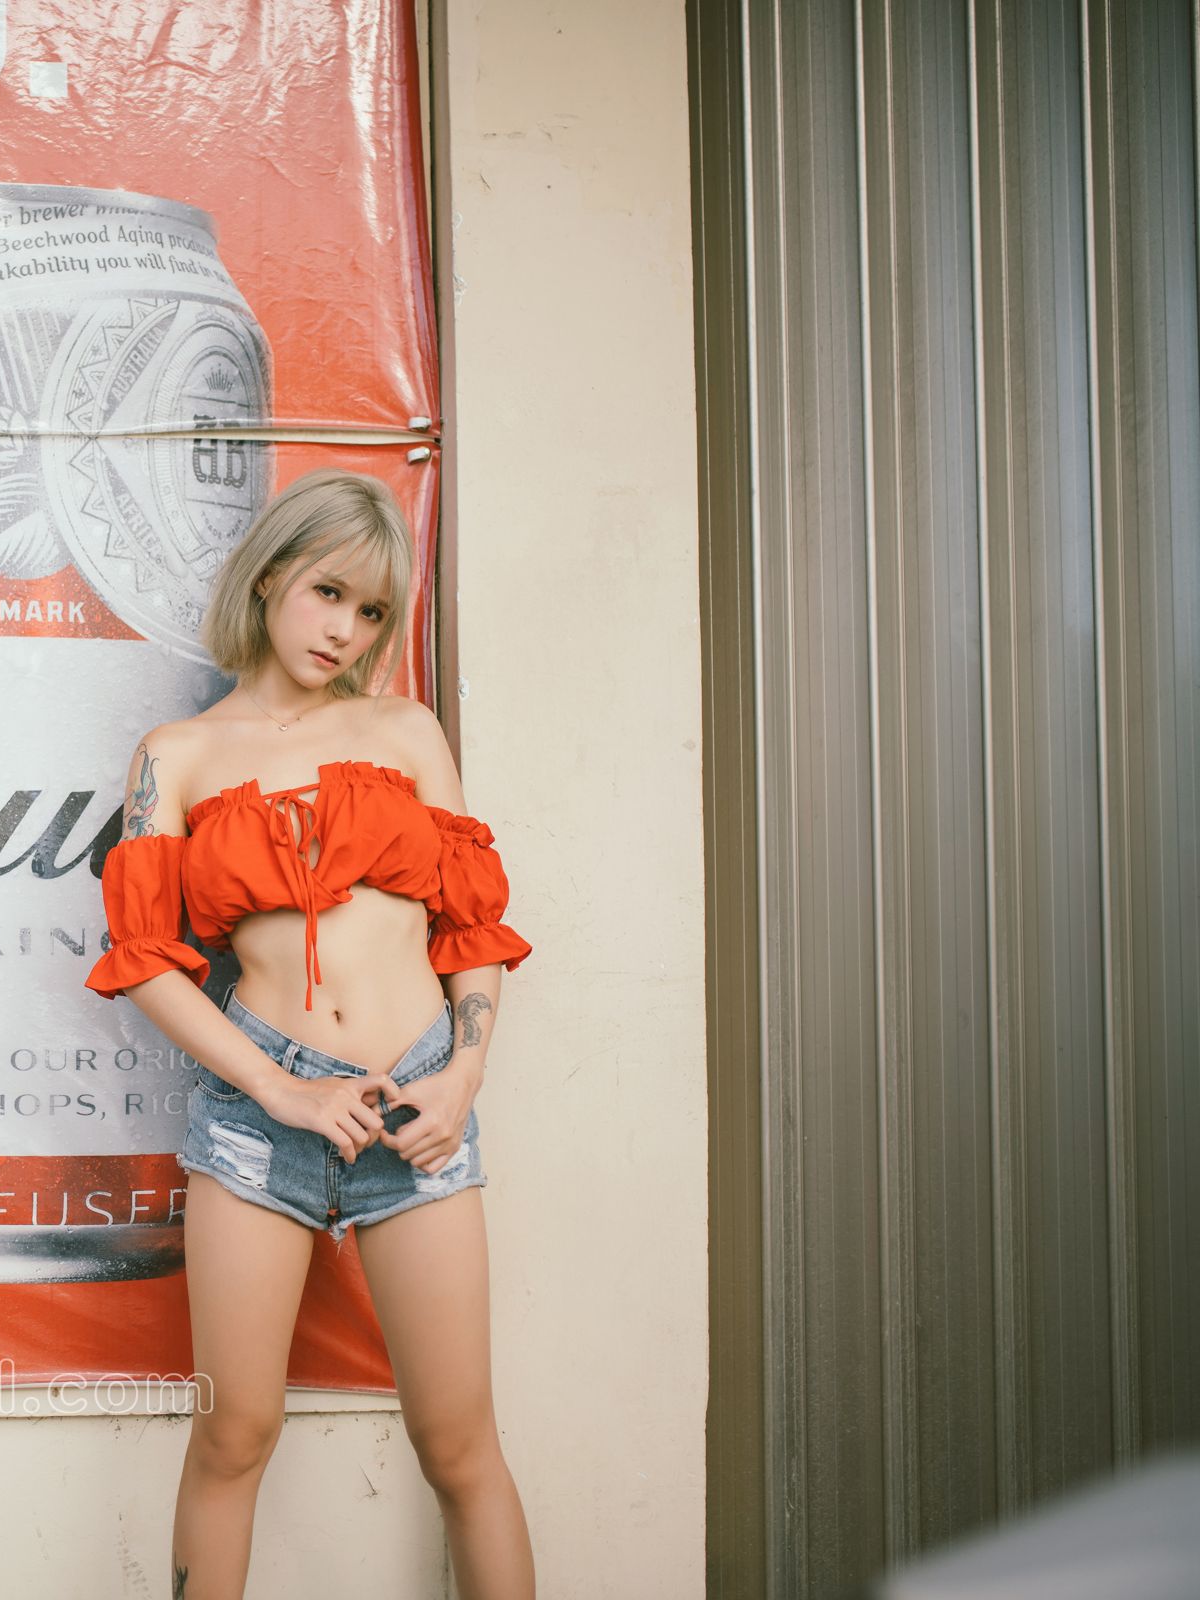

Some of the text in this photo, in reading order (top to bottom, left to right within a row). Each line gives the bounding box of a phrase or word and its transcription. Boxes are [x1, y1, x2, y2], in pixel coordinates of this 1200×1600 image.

[19, 201, 90, 226] brewer
[117, 225, 164, 248] Aging
[96, 256, 131, 273] you
[134, 253, 166, 270] will
[168, 255, 199, 274] find
[0, 599, 86, 623] MARK
[10, 1048, 98, 1072] OUR
[125, 1091, 192, 1115] RIC
